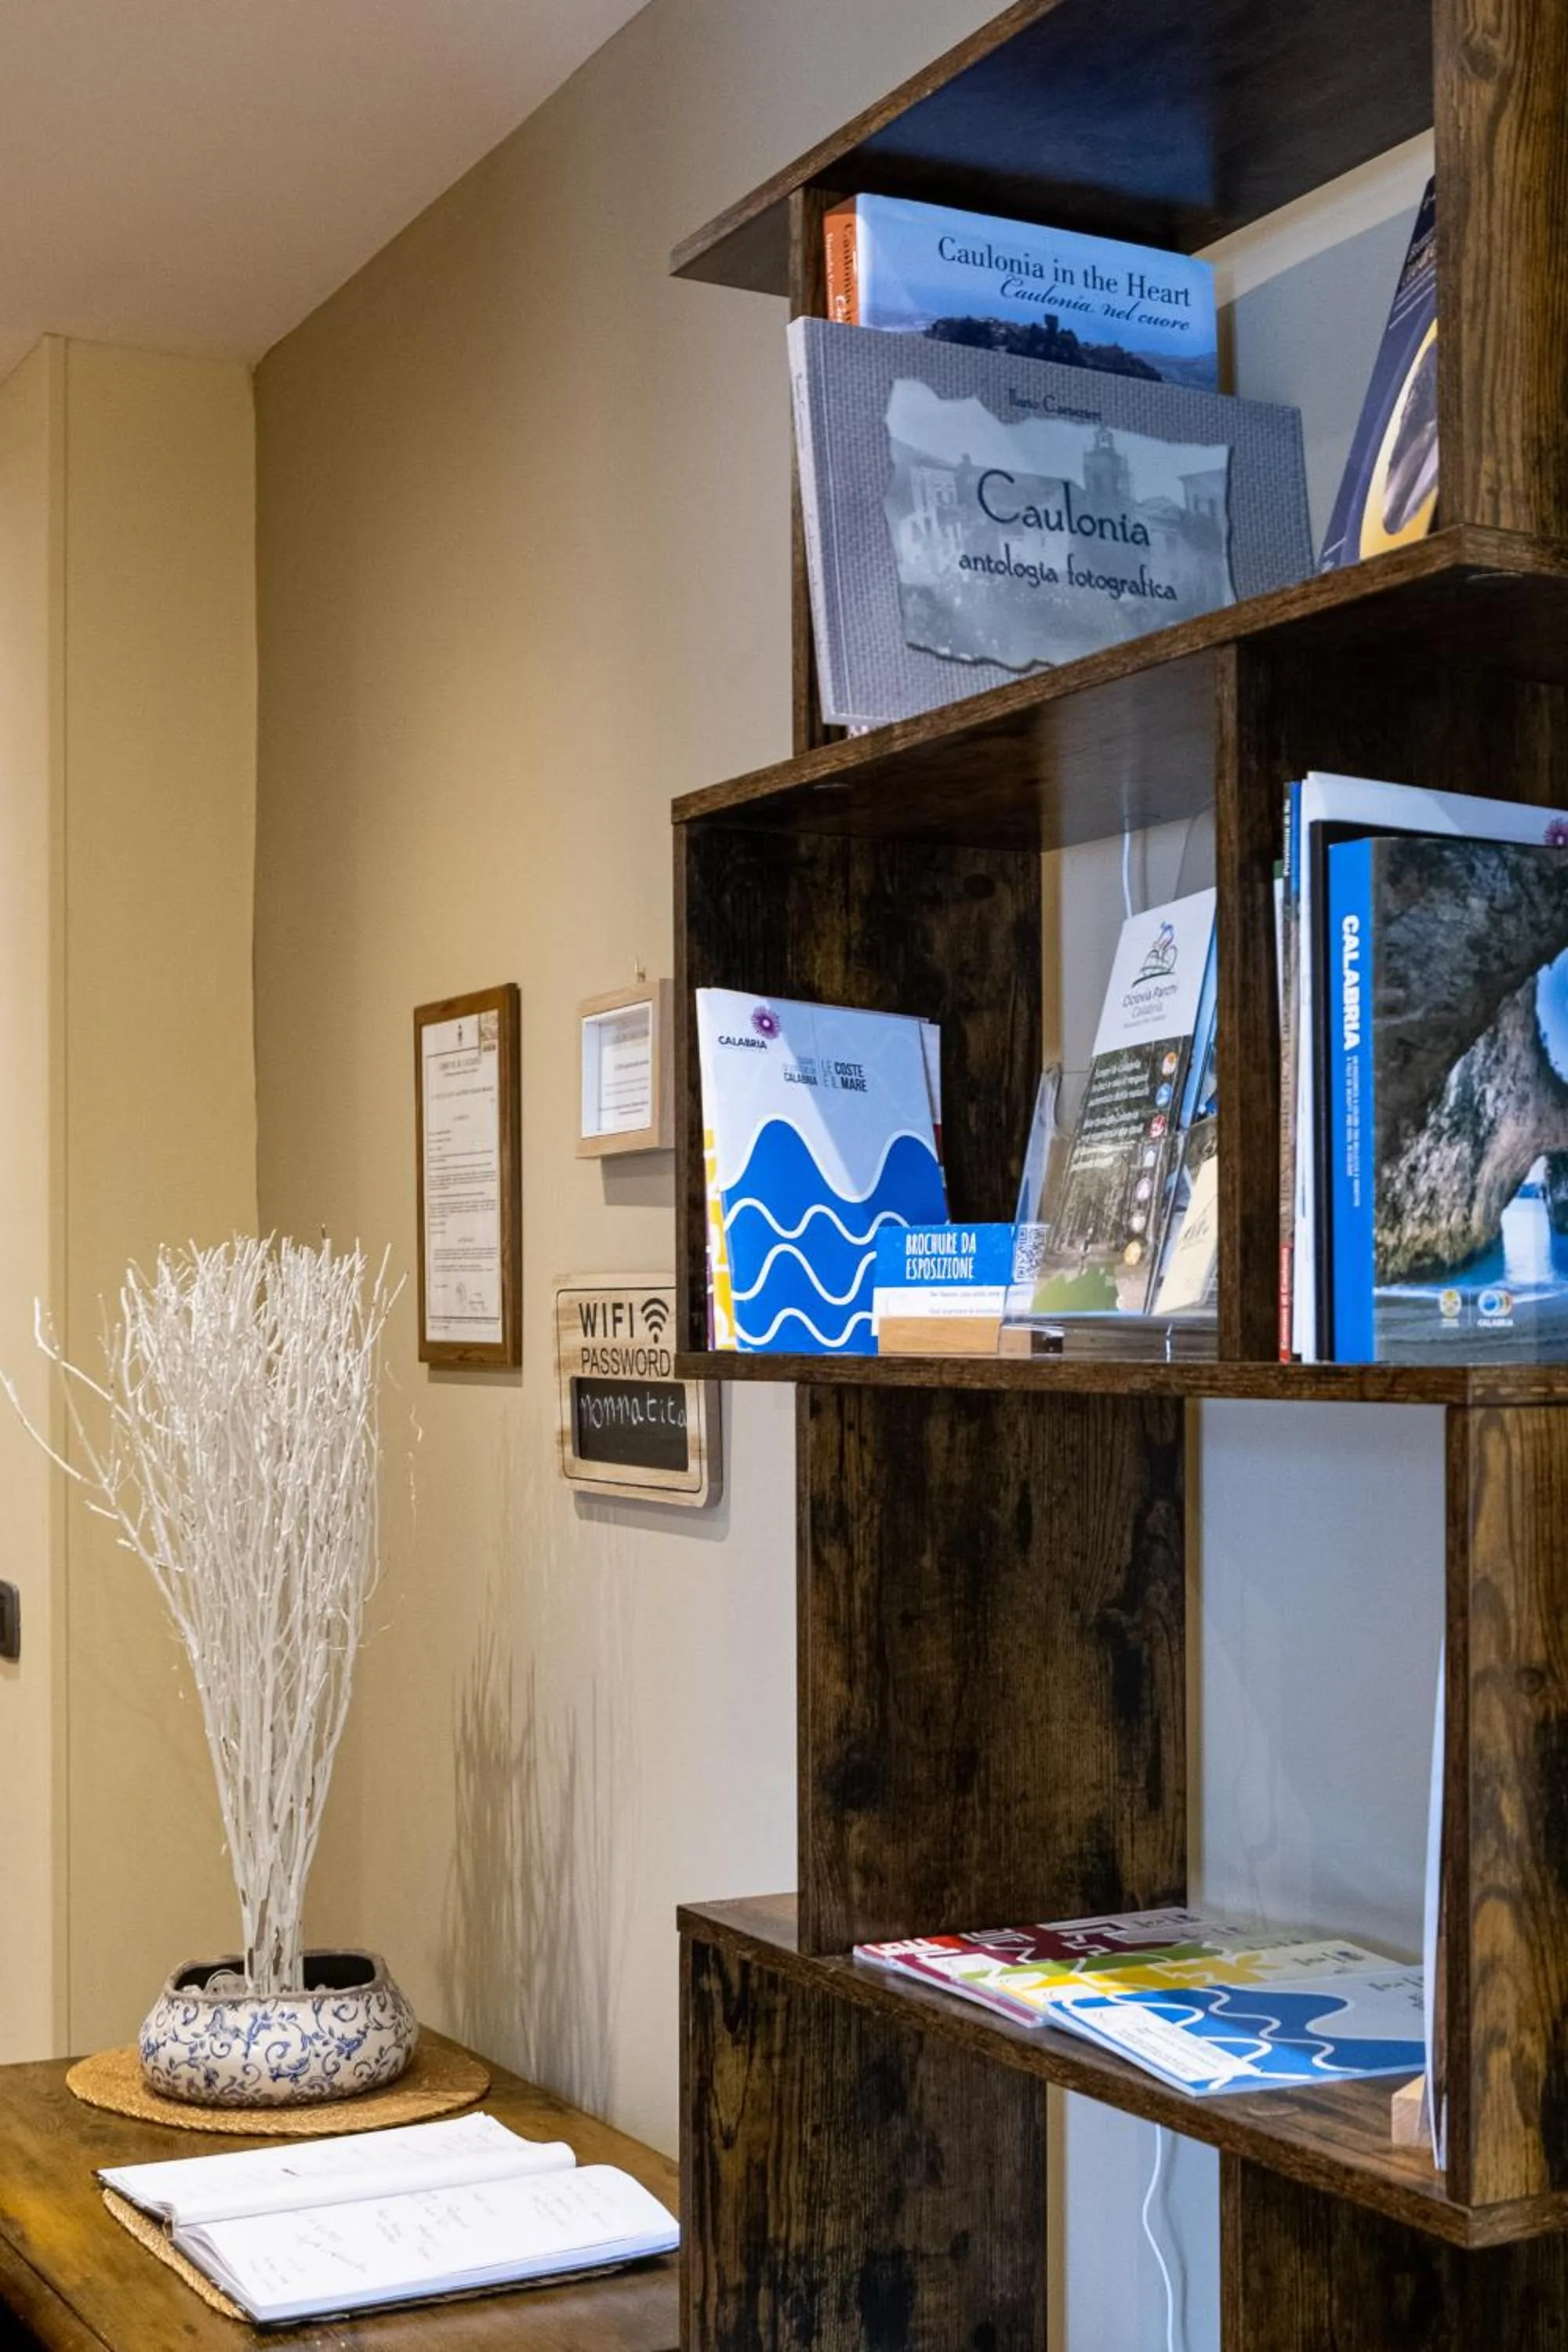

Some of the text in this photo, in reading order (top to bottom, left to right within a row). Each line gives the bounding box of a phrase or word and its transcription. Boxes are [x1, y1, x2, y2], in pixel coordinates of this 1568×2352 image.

[938, 236, 1191, 307] Caulonia in the Heart
[1000, 275, 1190, 331] Caulonia nel cuore
[978, 469, 1151, 546] Caulonia
[959, 543, 1178, 601] antologia fotografica
[1342, 915, 1360, 1051] CALABRIA
[718, 1036, 768, 1050] CALABRIA
[834, 1061, 865, 1078] COSTE
[840, 1076, 868, 1092] MARE
[906, 1232, 978, 1255] BROCHURE DA
[906, 1257, 975, 1279] ESPOSIZIONE
[579, 1302, 634, 1338] WIFI
[581, 1346, 671, 1377] PASSWORD
